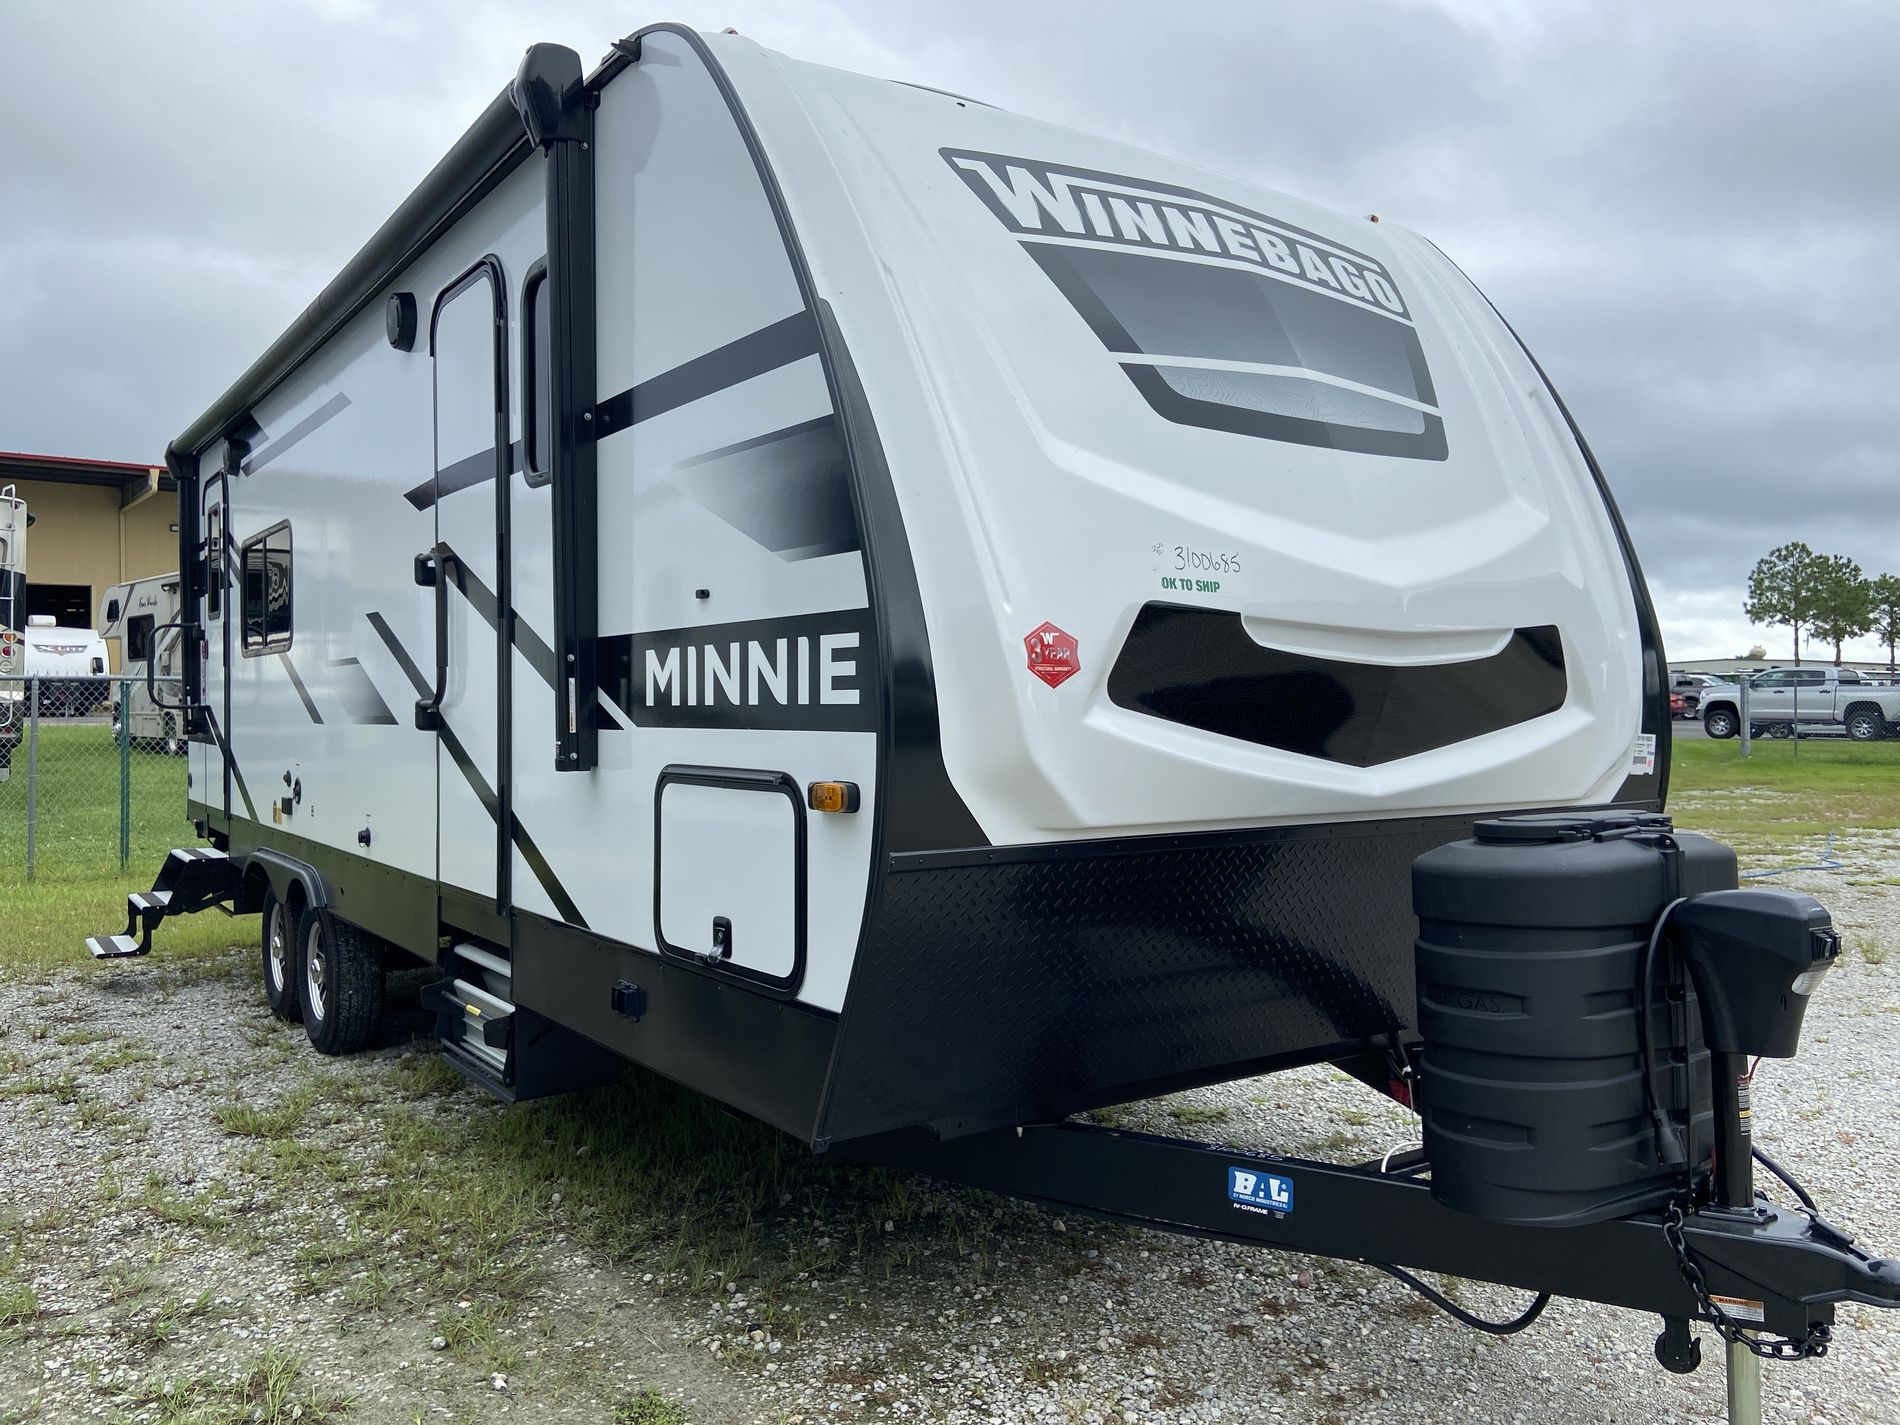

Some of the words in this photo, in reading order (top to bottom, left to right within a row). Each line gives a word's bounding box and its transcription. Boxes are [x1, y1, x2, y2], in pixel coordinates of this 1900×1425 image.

[951, 156, 1404, 314] WINNEBAGO
[1174, 545, 1241, 574] 3100685
[1161, 576, 1177, 590] OK
[1179, 578, 1193, 591] TO
[1195, 579, 1221, 593] SHIP
[645, 631, 860, 707] MINNIE
[1457, 992, 1501, 1013] GAS
[1233, 1171, 1289, 1202] BAL
